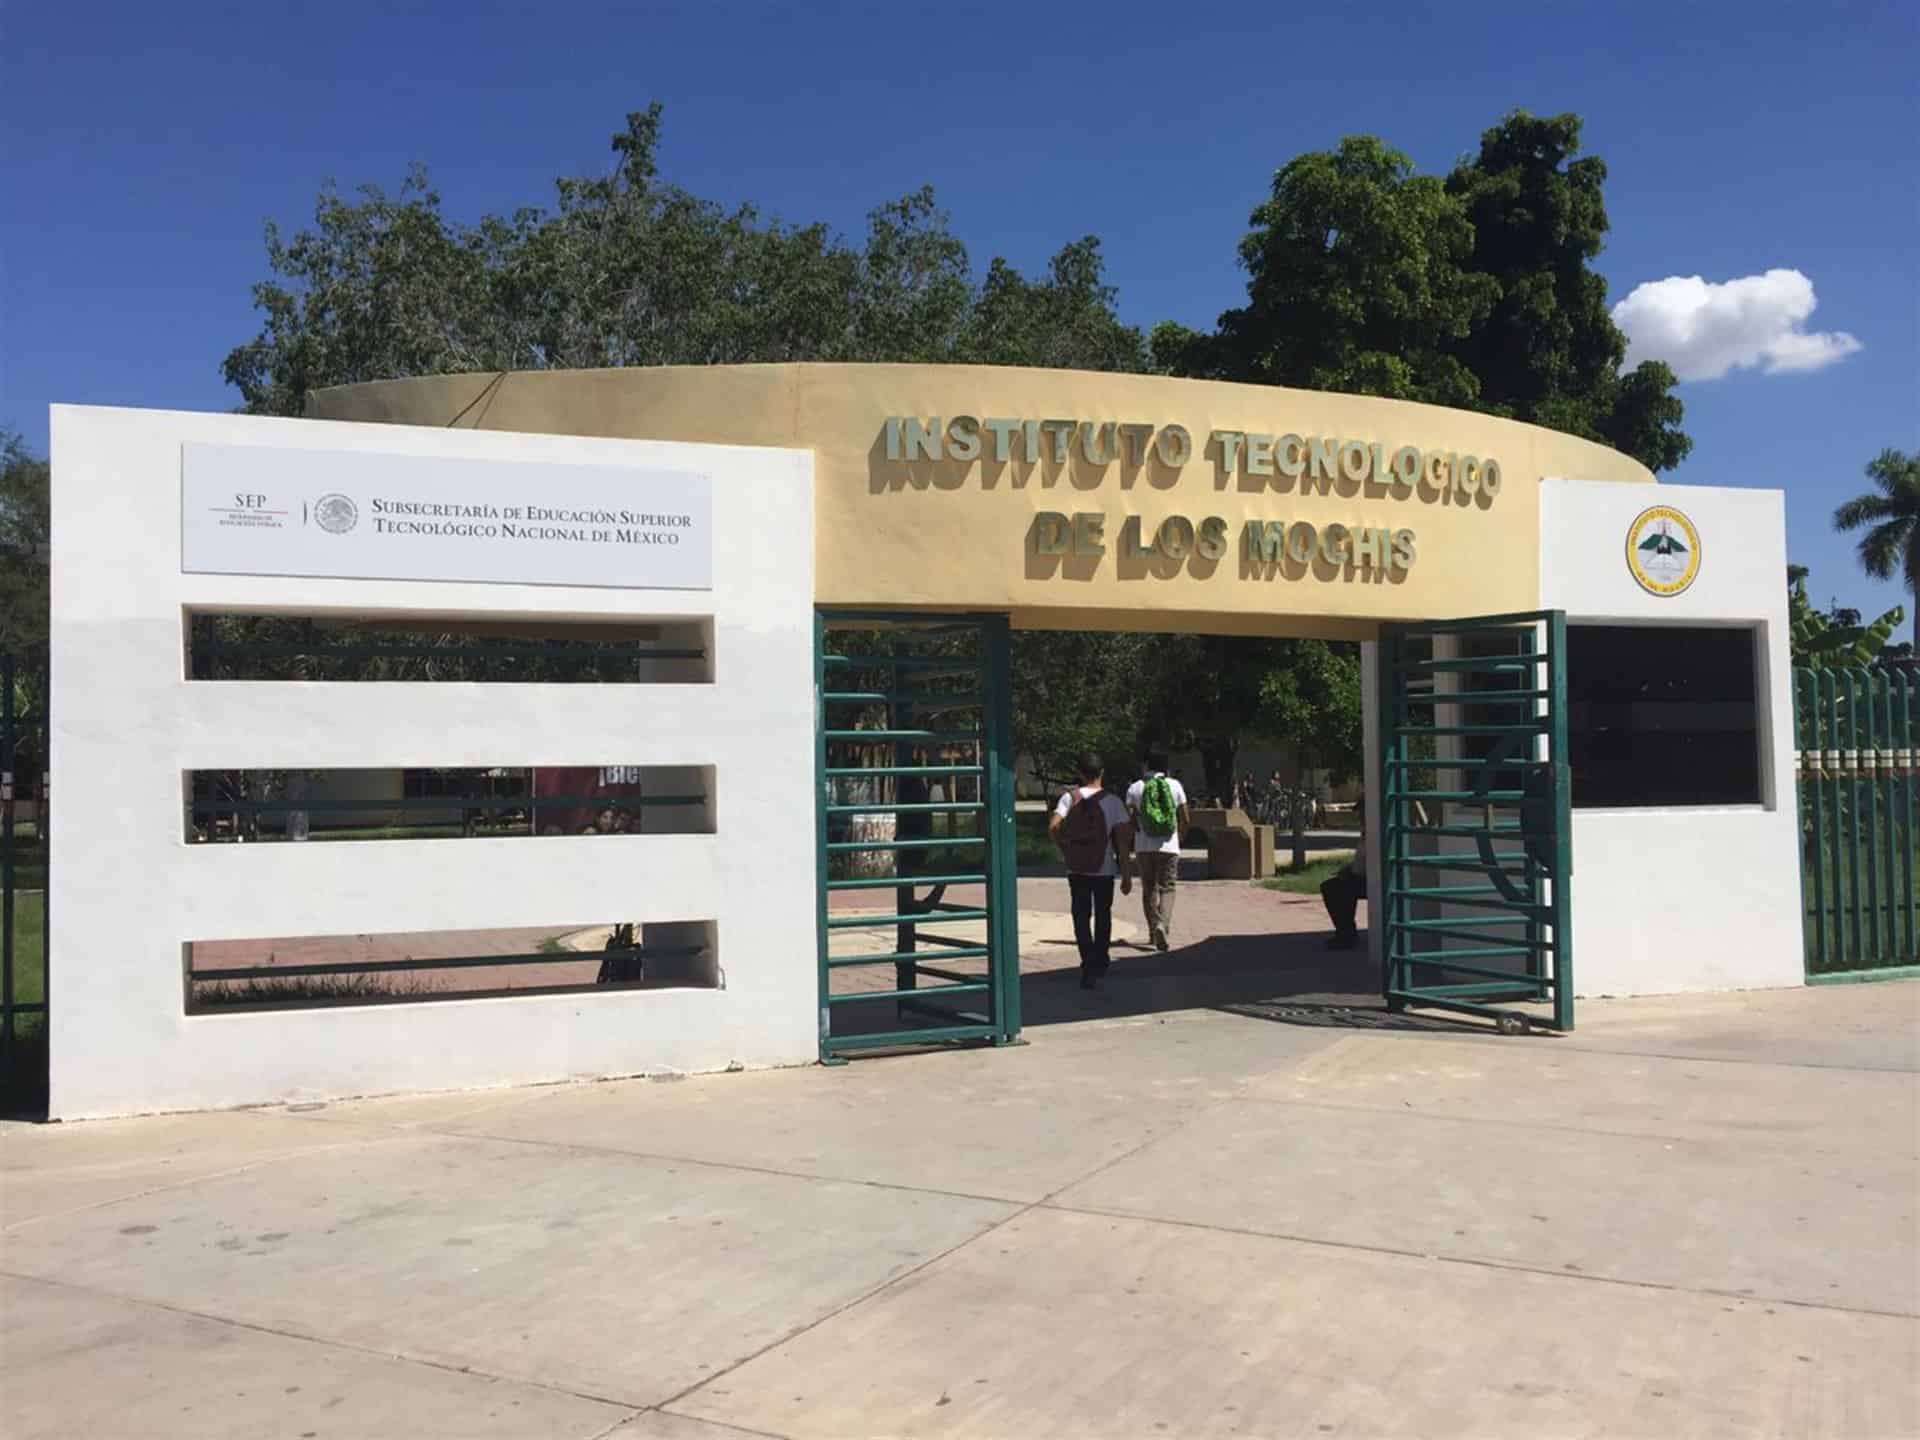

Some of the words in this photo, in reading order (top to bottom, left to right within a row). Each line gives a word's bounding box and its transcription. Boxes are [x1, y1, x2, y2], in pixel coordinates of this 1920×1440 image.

[884, 415, 1192, 468] INSTITUTO
[1210, 430, 1501, 497] TECNOLOGICO
[234, 493, 267, 508] SEP
[372, 498, 498, 519] SUBSECRETARÍA
[503, 507, 522, 520] DE
[527, 505, 617, 525] EDUCACIÓN
[619, 510, 692, 528] SUPERIOR
[373, 517, 497, 538] TECNOLÓGICO
[501, 522, 588, 542] NACIONAL
[591, 529, 613, 543] DE
[616, 528, 680, 545] MÉXICO
[1036, 511, 1105, 555] DE
[1123, 515, 1228, 560] LOS
[1246, 520, 1417, 569] MOCHIS
